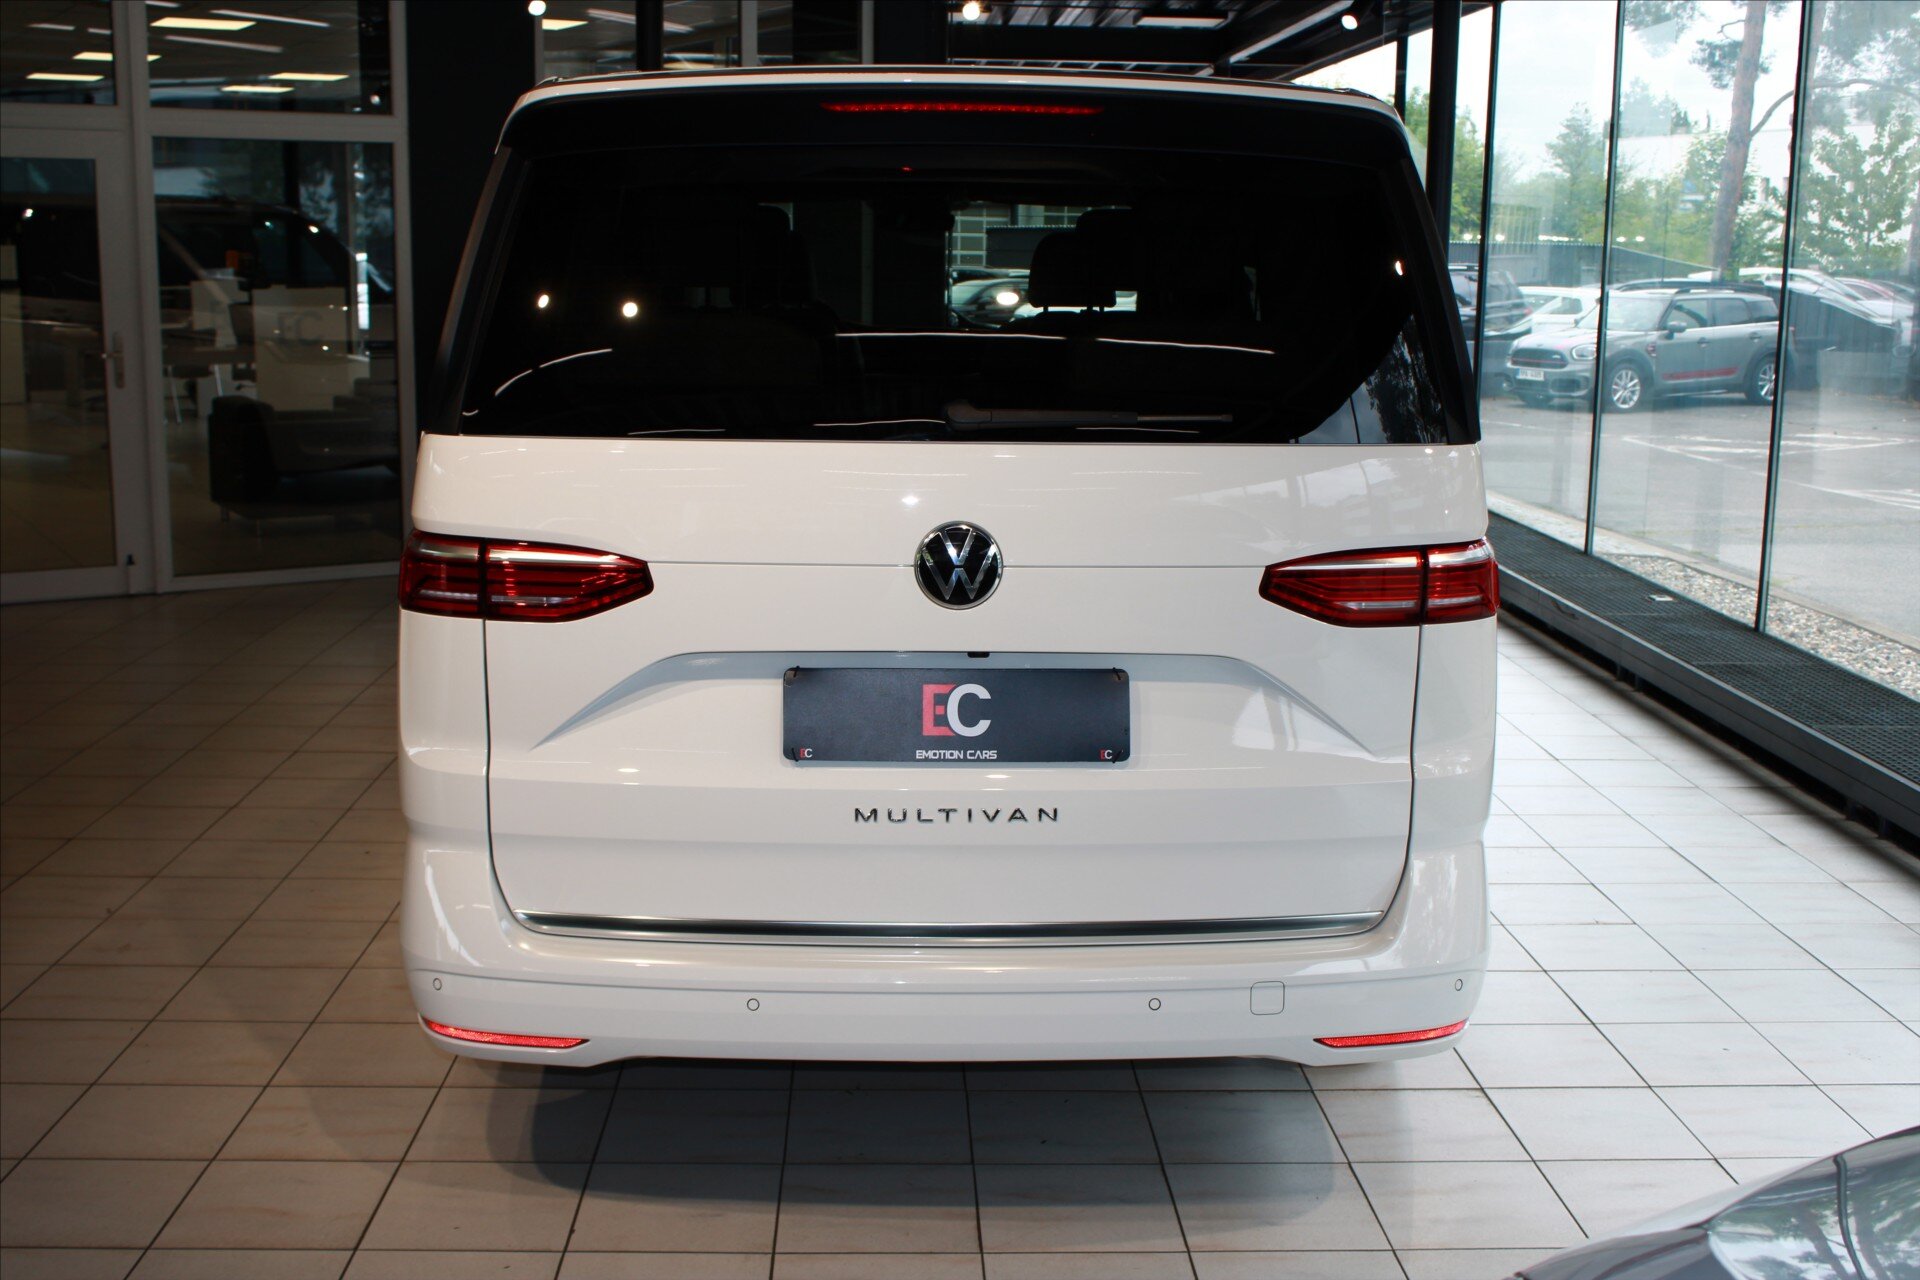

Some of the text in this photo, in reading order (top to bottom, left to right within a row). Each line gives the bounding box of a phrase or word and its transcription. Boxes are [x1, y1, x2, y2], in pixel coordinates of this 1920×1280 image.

[922, 683, 992, 737] EC
[915, 749, 998, 760] EMOTION CARS
[854, 807, 1059, 823] MULTIVAN
